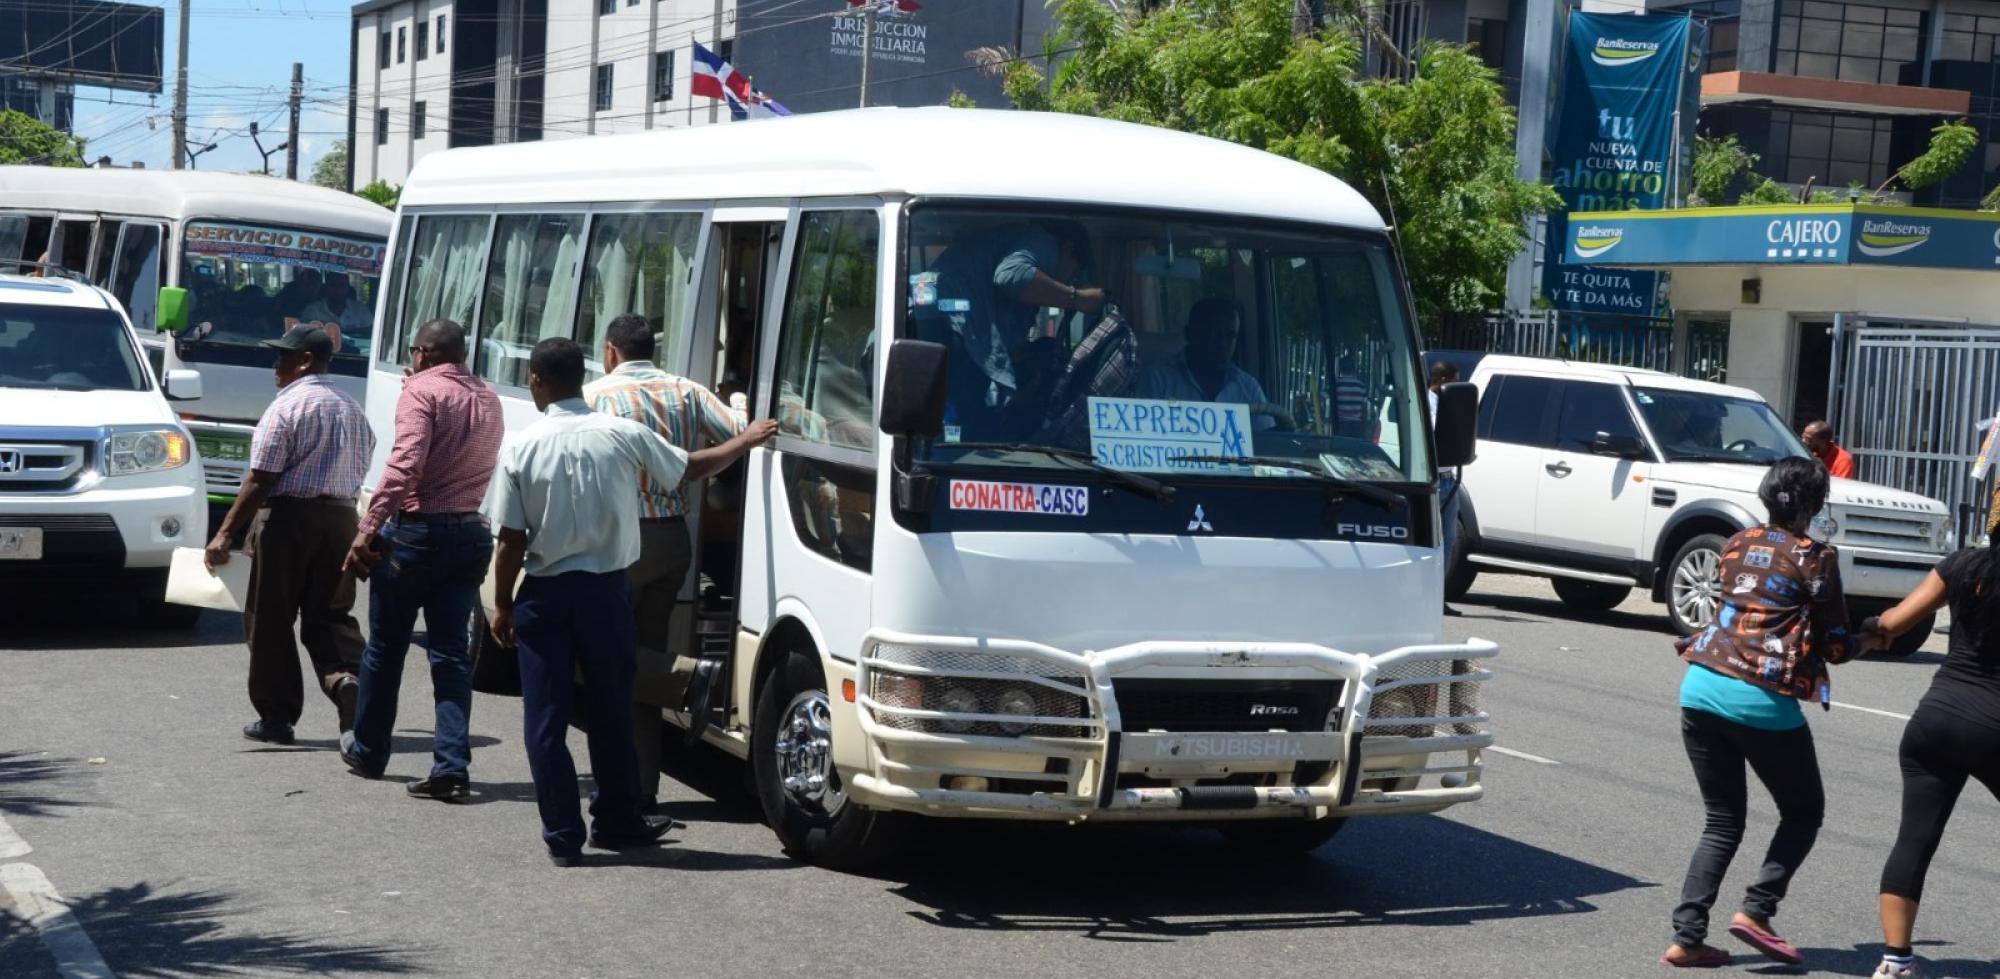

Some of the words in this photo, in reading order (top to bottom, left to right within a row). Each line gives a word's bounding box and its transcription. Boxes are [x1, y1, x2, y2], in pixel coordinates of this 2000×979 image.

[831, 32, 926, 54] INMOILIARIA
[1596, 37, 1660, 50] BanReservas
[1598, 108, 1635, 140] tu
[1588, 141, 1637, 156] NUEVA
[1585, 156, 1639, 171] CUENTA
[1643, 160, 1663, 173] DE
[1553, 158, 1663, 194] ahorro
[1578, 225, 1624, 238] BanReservas
[1766, 219, 1842, 247] CAJERO
[1862, 219, 1932, 236] BanReservas
[186, 226, 293, 247] SERVICIO
[297, 235, 375, 259] RAPIDO
[1563, 271, 1580, 285] TE
[1582, 273, 1631, 290] QUITA
[1552, 288, 1561, 301] Y
[1565, 289, 1581, 303] TE
[1585, 291, 1607, 305] DA
[1610, 292, 1643, 309] MÁS
[1095, 402, 1218, 436] EXPRESO
[952, 482, 1087, 515] CONATRA-CASC
[1846, 496, 1885, 506] LAND
[1891, 501, 1932, 511] ROVER
[1337, 523, 1409, 539] FUSO
[1155, 737, 1290, 757] MTSUBISHI
